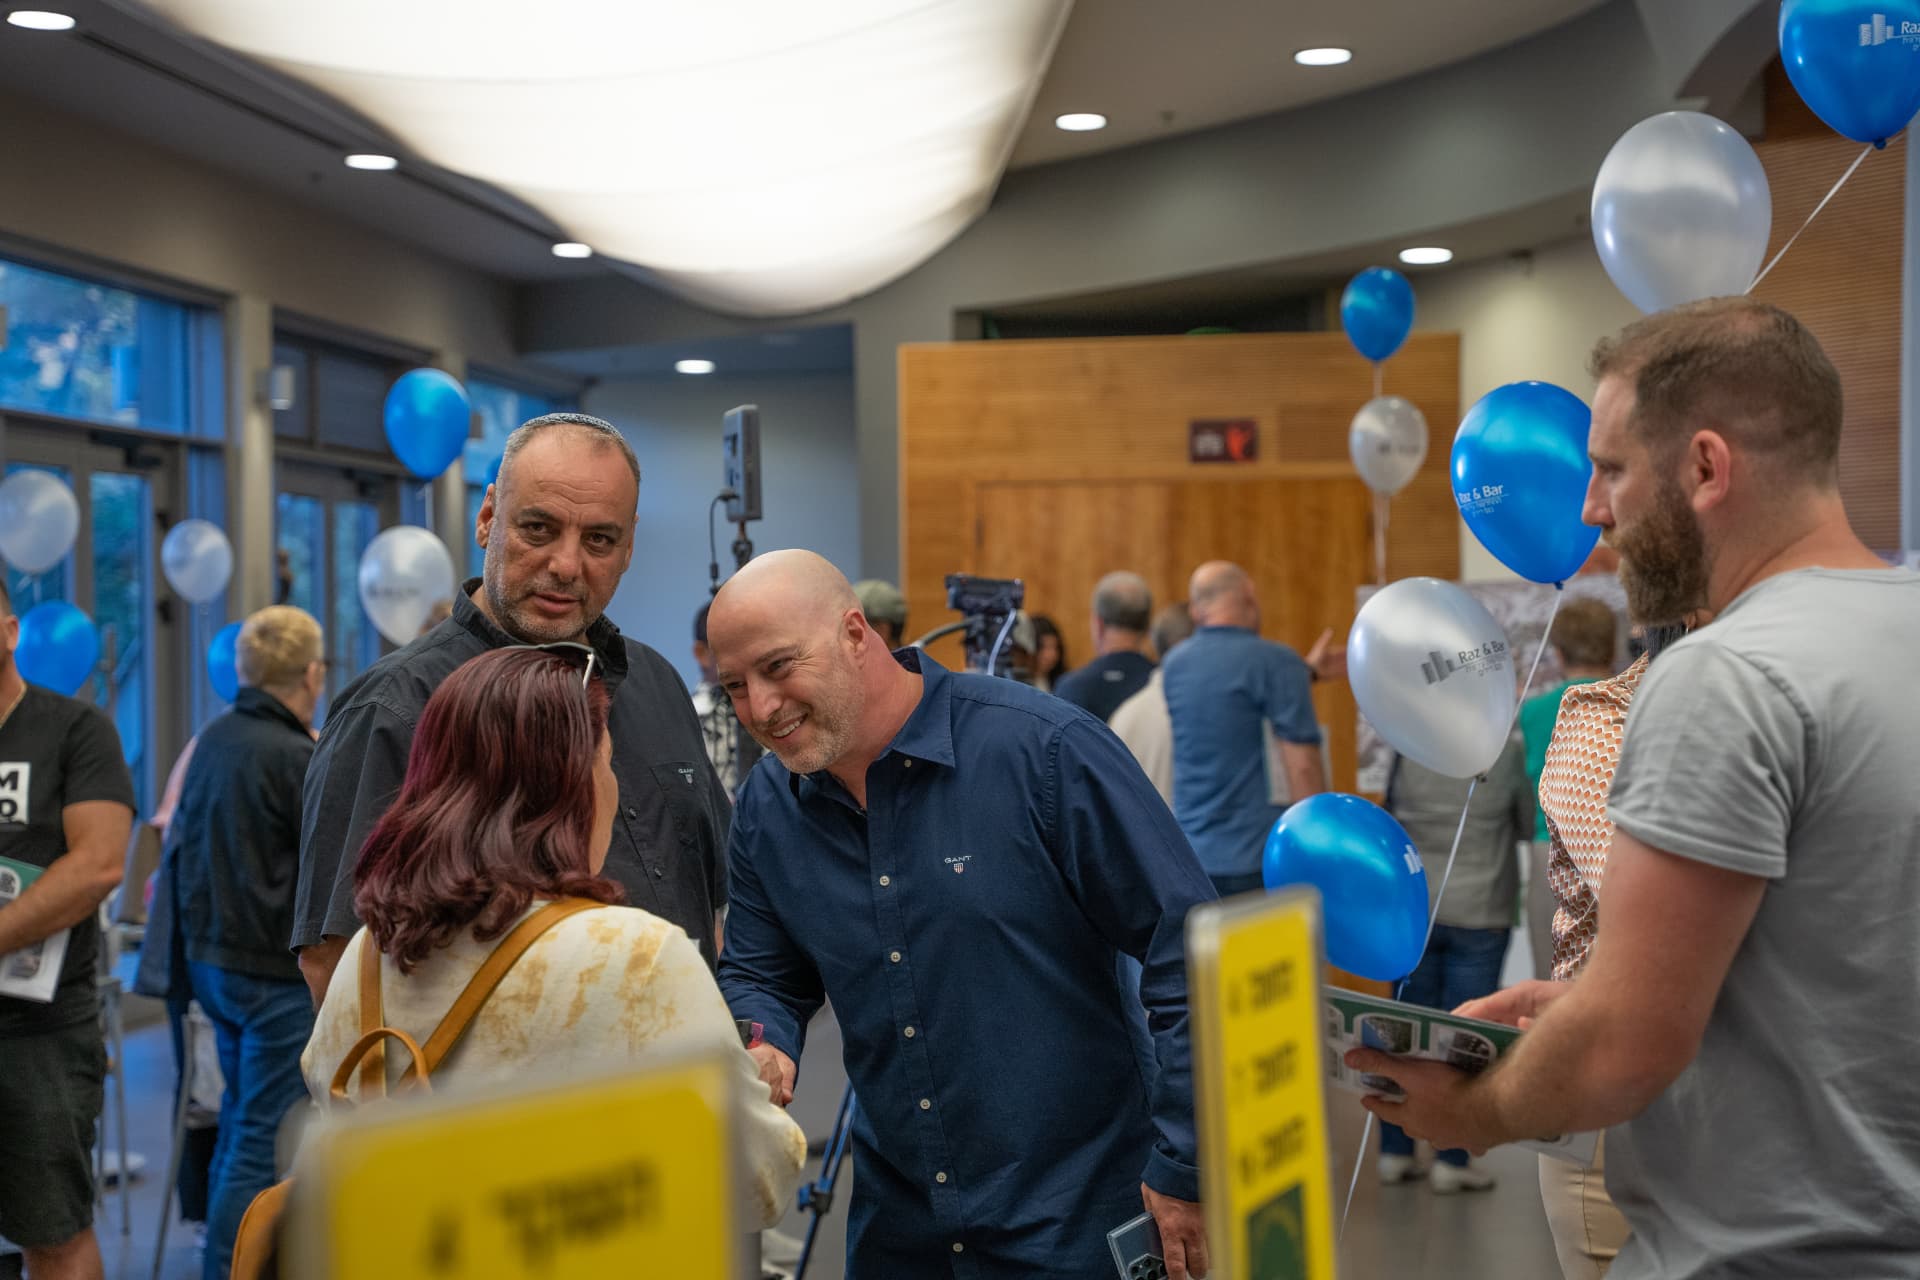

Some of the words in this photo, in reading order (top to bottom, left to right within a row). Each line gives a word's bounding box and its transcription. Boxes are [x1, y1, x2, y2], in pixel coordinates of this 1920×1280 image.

[1482, 484, 1504, 498] Bar
[1458, 647, 1480, 664] Raz
[1482, 642, 1491, 656] &
[944, 855, 972, 864] GANT
